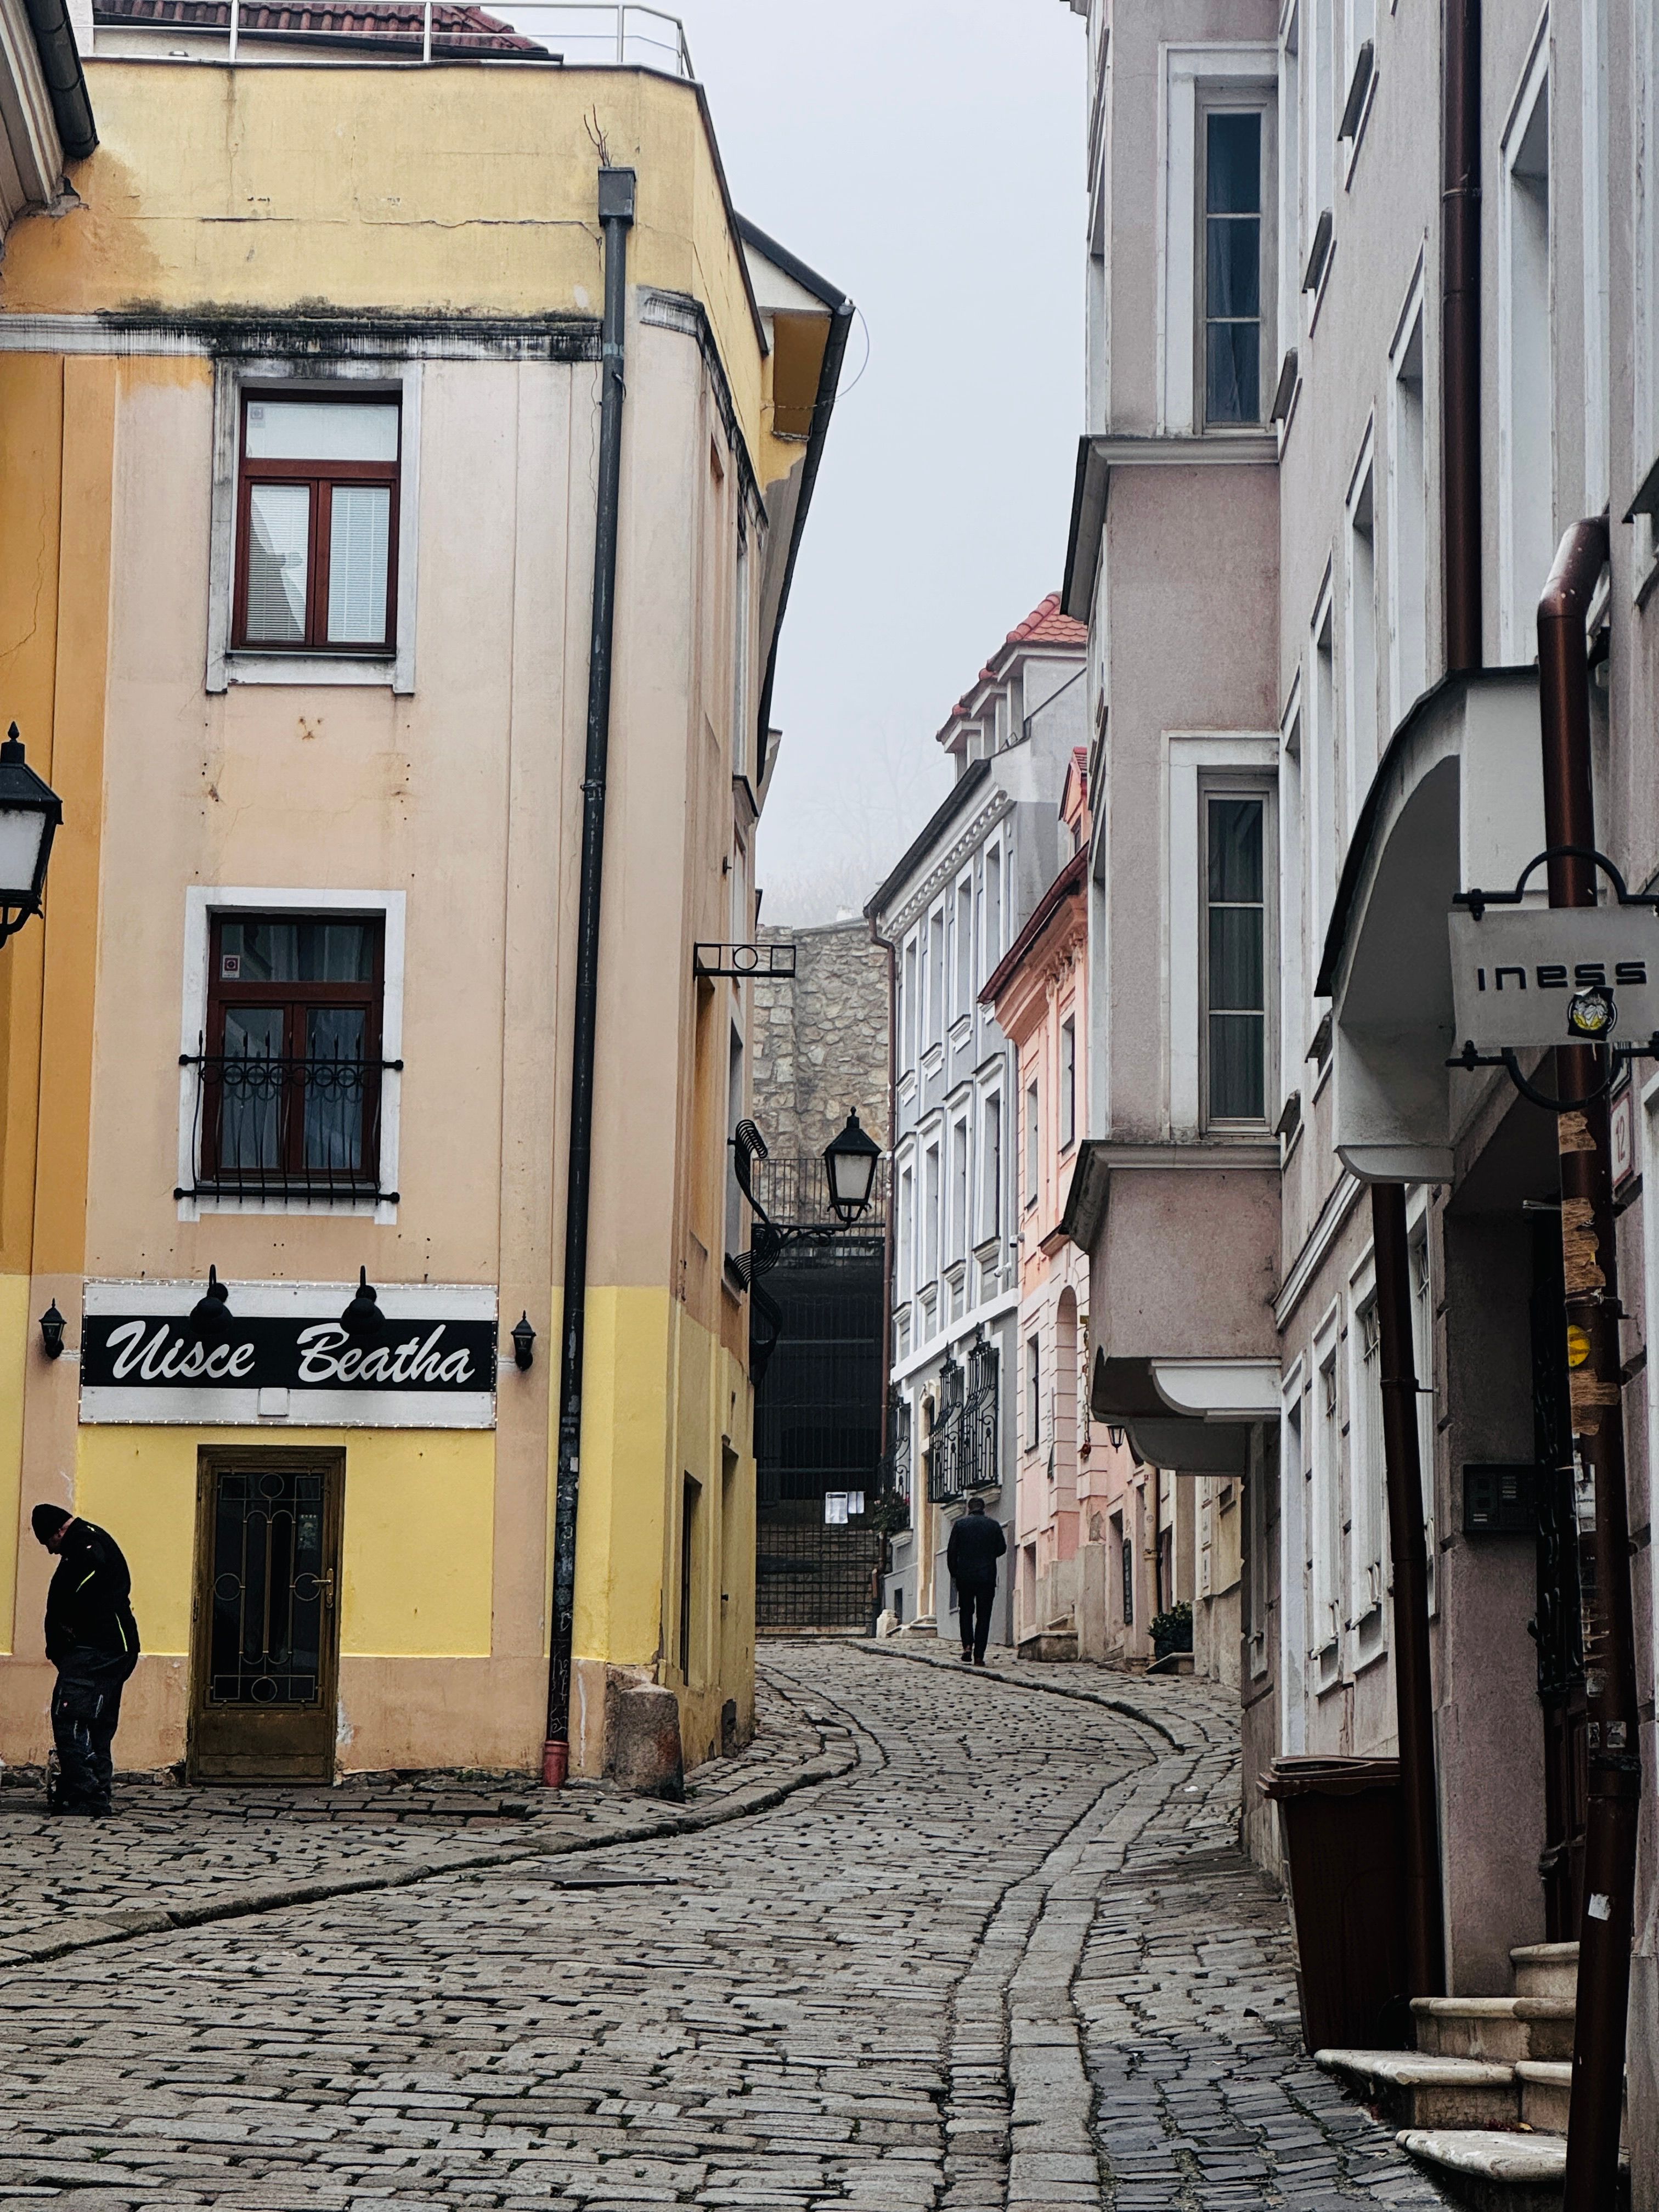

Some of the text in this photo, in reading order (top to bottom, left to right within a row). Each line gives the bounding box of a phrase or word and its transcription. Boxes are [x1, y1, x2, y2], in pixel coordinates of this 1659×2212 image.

[1616, 1115, 1626, 1163] 12
[106, 1320, 476, 1383] Uisce Beatha
